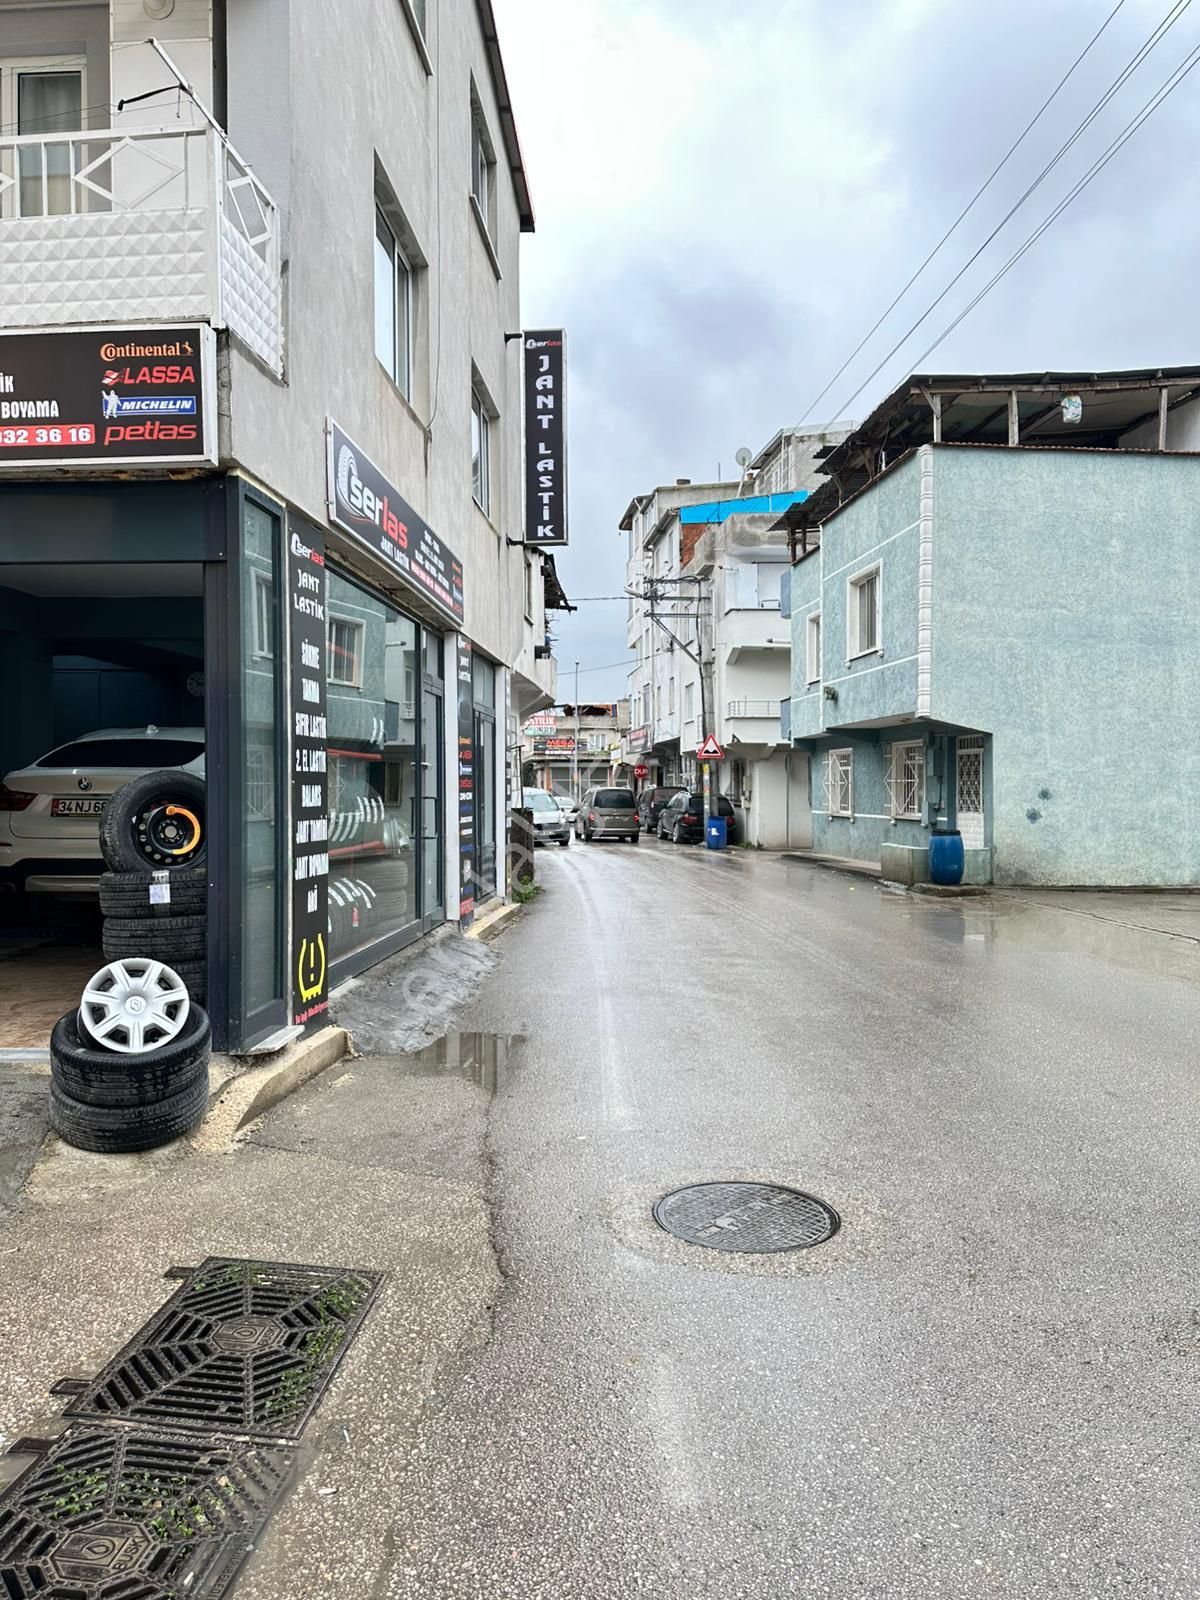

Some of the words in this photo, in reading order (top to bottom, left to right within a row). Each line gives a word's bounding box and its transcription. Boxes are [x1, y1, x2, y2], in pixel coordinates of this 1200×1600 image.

[100, 342, 180, 362] Continental
[124, 366, 195, 384] LASSA
[535, 355, 554, 429] JANT
[1, 400, 59, 419] BOYAMA
[121, 399, 193, 411] MICHELIN
[0, 428, 29, 444] 32
[35, 428, 62, 443] 36
[68, 427, 91, 442] 16
[104, 421, 197, 446] petlas
[537, 442, 555, 537] LASTİK
[297, 568, 320, 594] JANT
[293, 593, 325, 621] LASTİK
[59, 801, 73, 813] 34
[75, 801, 92, 813] NJ
